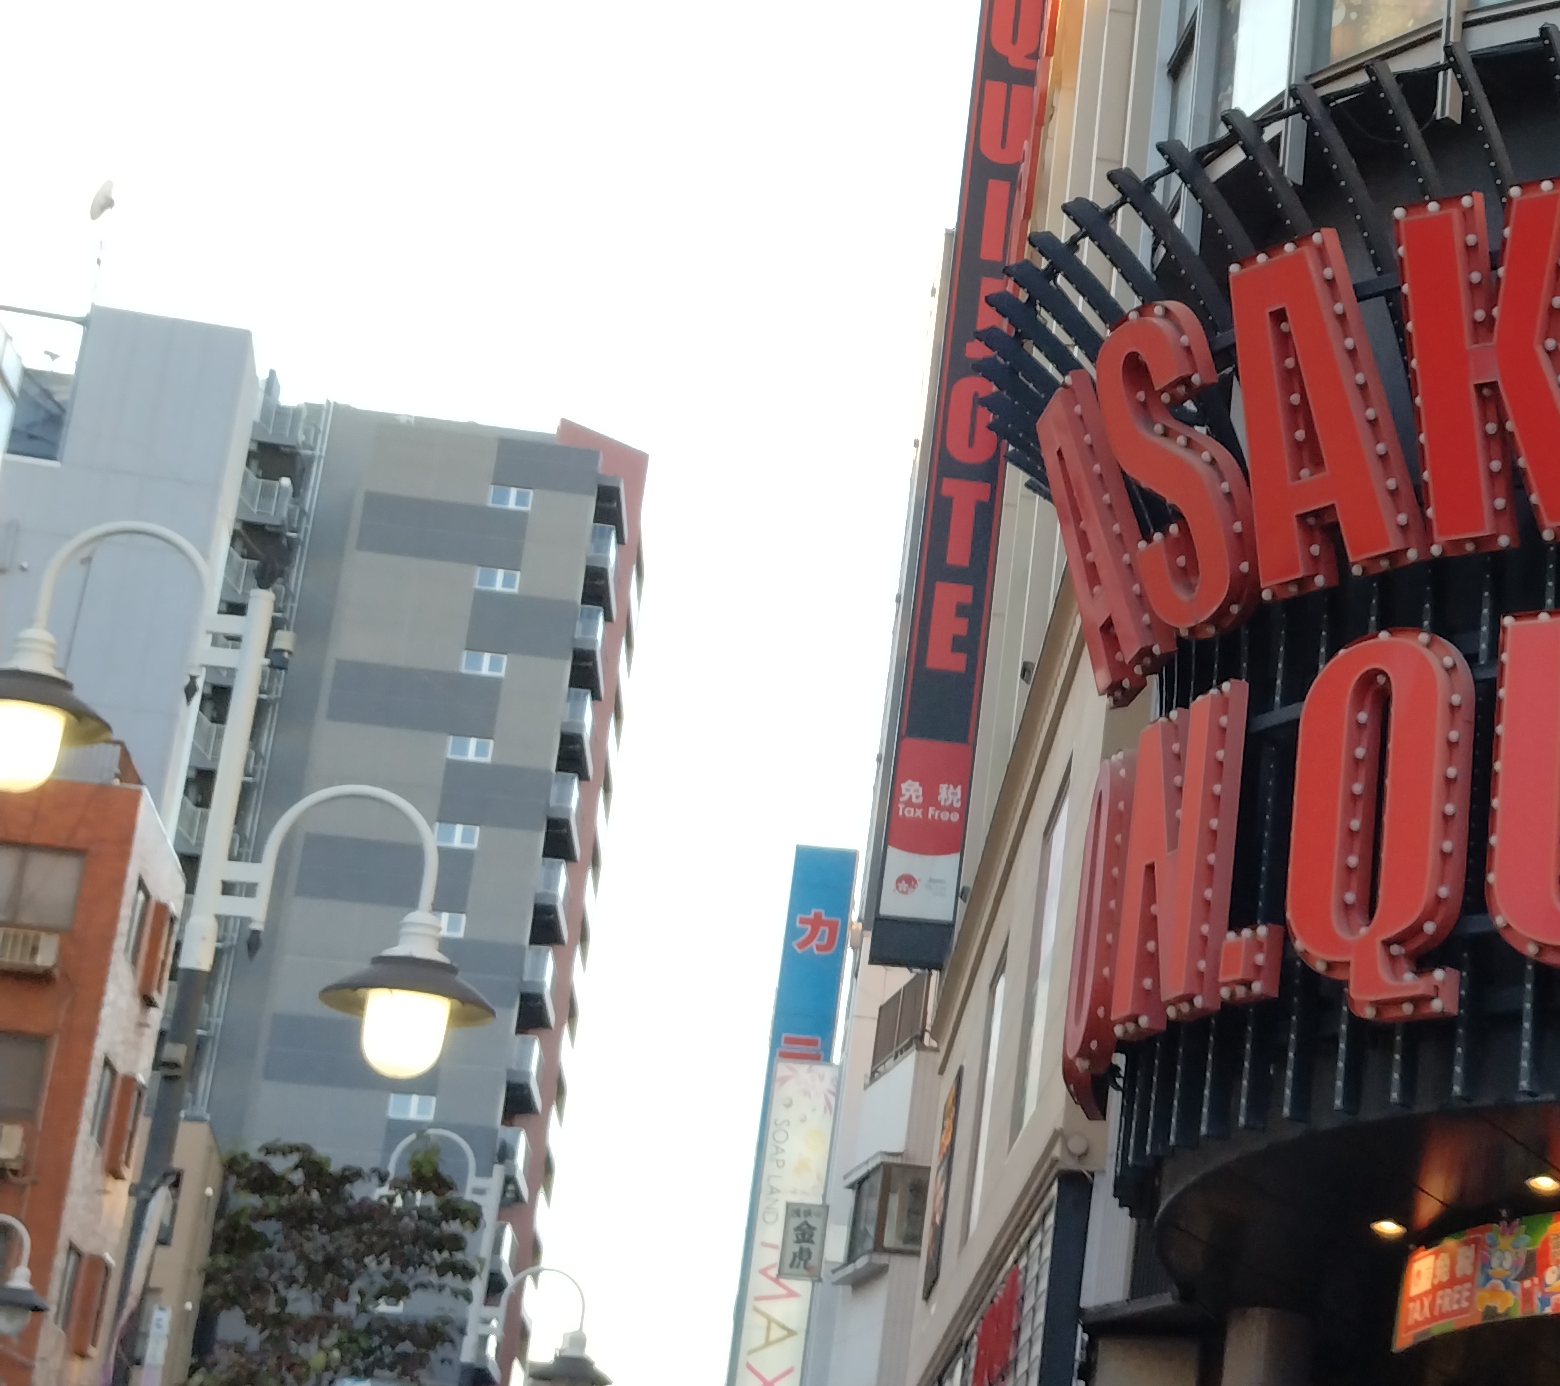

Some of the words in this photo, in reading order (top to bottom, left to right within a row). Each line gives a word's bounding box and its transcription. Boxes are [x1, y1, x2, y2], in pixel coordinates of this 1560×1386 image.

[898, 803, 923, 819] Tax
[927, 806, 960, 823] Free
[1434, 1282, 1473, 1316] FREE
